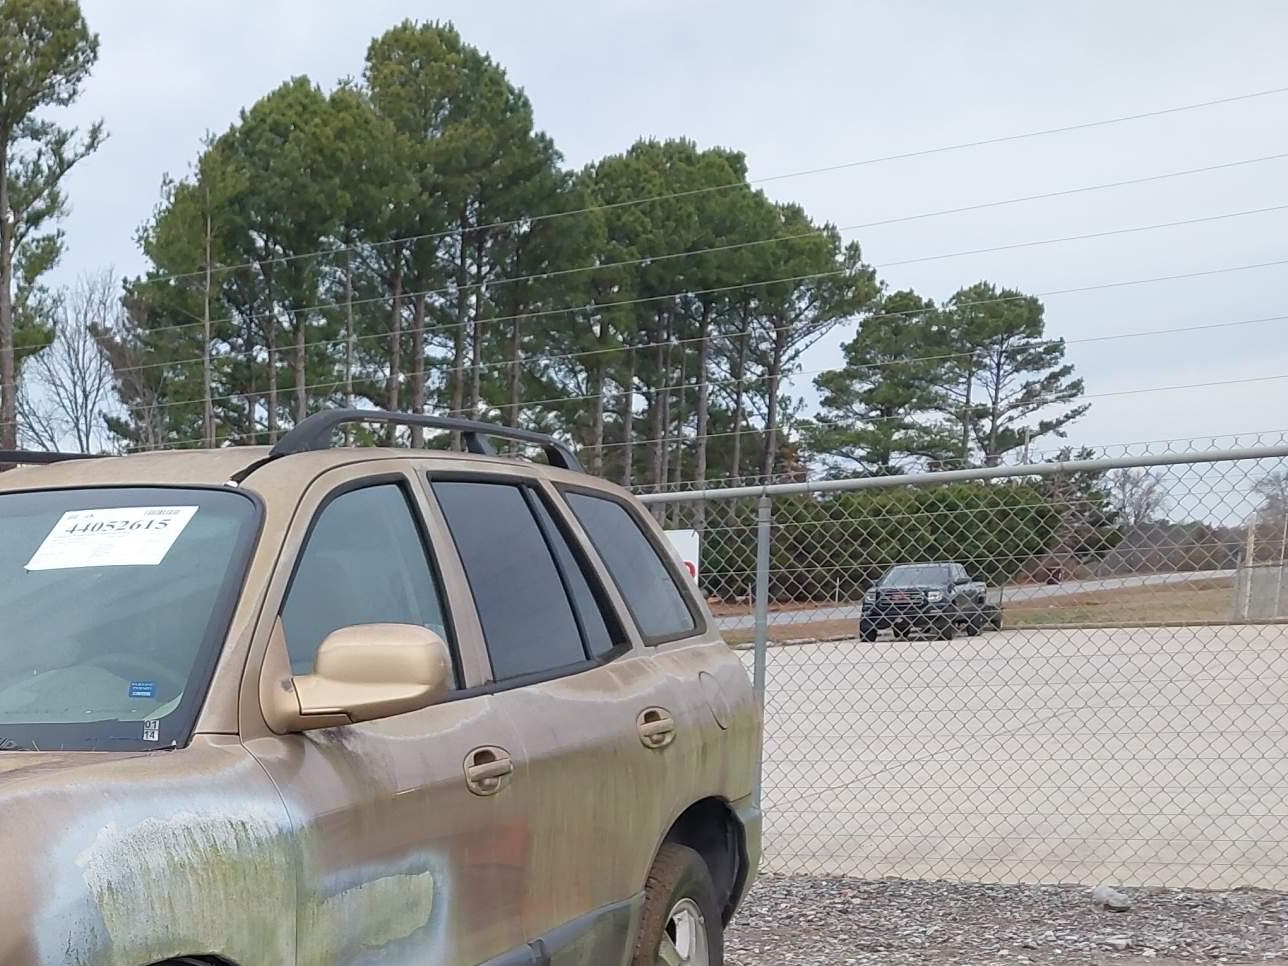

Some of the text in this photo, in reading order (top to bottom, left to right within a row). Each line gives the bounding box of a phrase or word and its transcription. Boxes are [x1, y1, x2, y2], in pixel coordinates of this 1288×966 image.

[65, 518, 172, 534] 44052615
[145, 720, 157, 729] 01
[145, 731, 155, 739] 14
